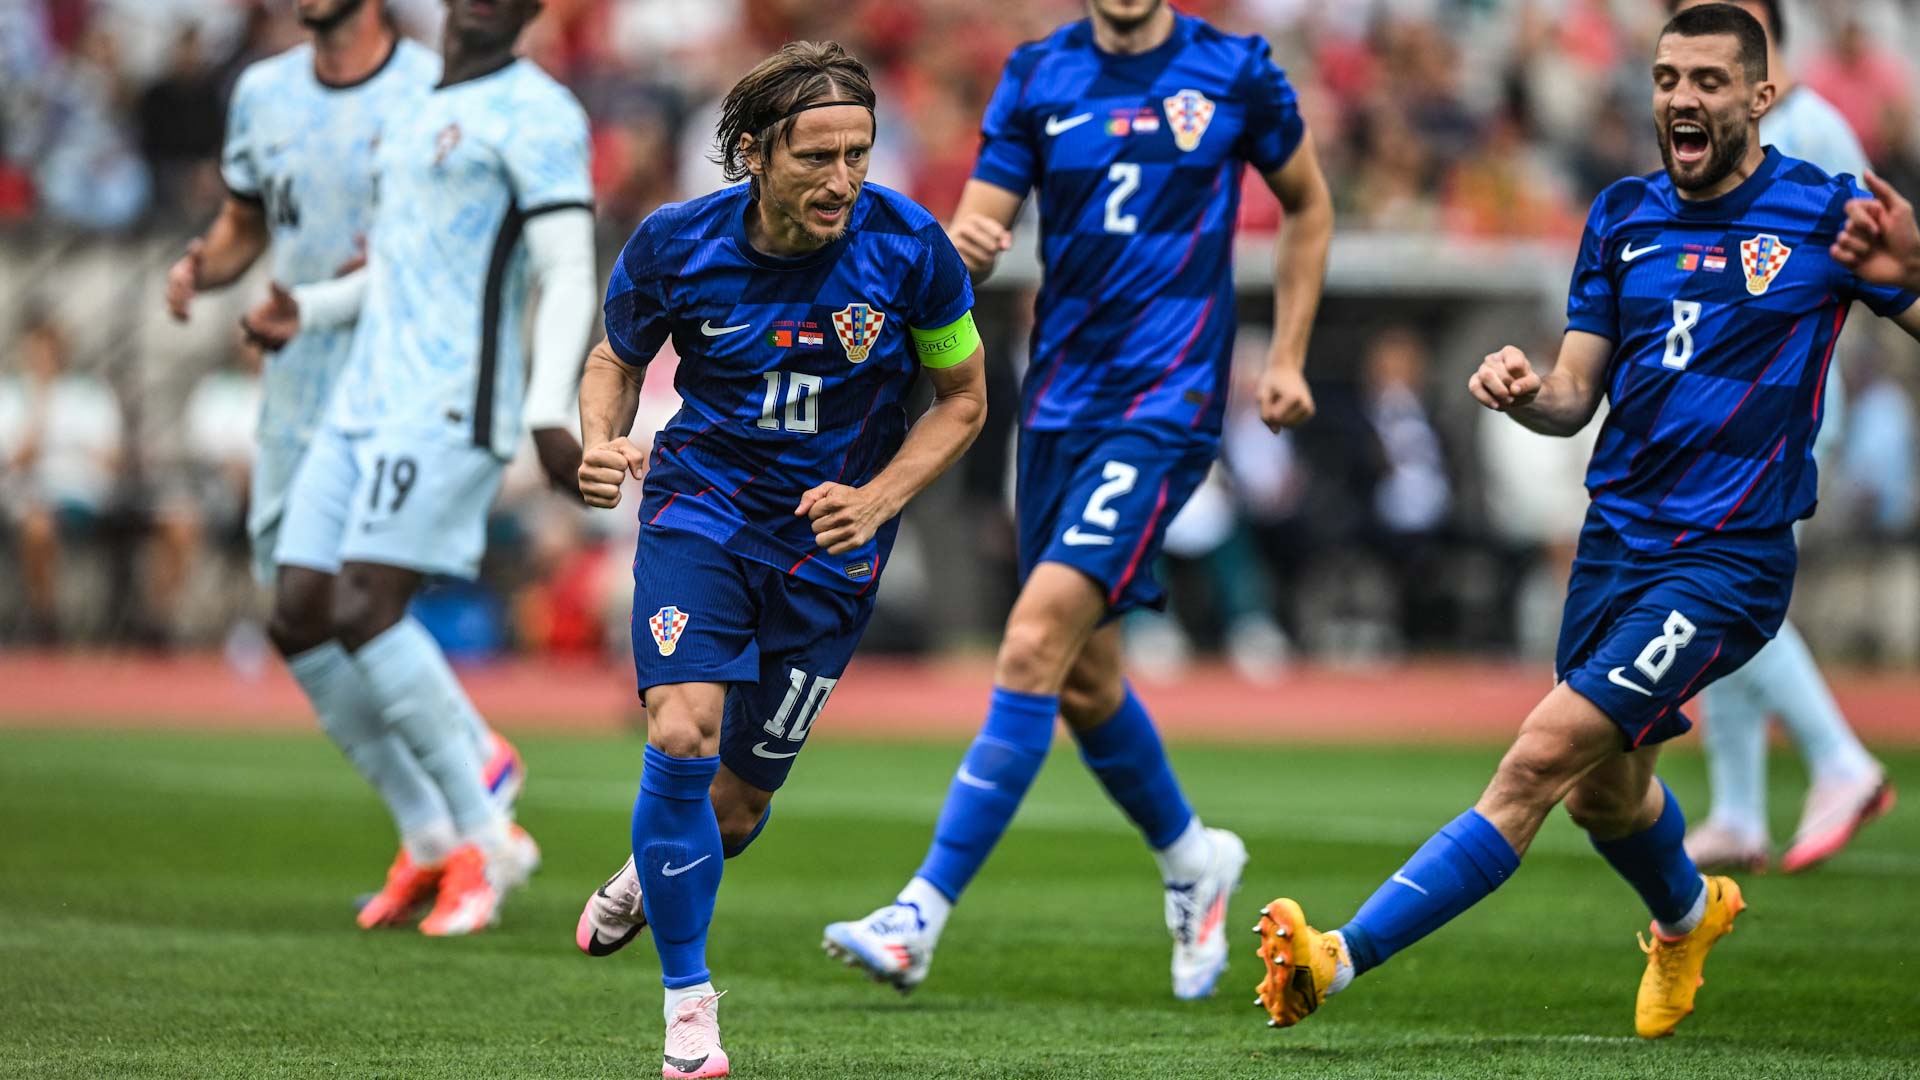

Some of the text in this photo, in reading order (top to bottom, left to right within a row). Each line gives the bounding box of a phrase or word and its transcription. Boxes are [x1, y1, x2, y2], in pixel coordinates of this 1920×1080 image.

[1104, 163, 1140, 234] 2
[855, 310, 863, 340] HNS
[915, 335, 958, 353] ESPECT
[1662, 300, 1702, 370] 8
[757, 371, 823, 434] 10
[369, 455, 418, 514] 19
[1082, 460, 1139, 531] 2
[1634, 609, 1697, 684] 8
[763, 667, 838, 742] 10
